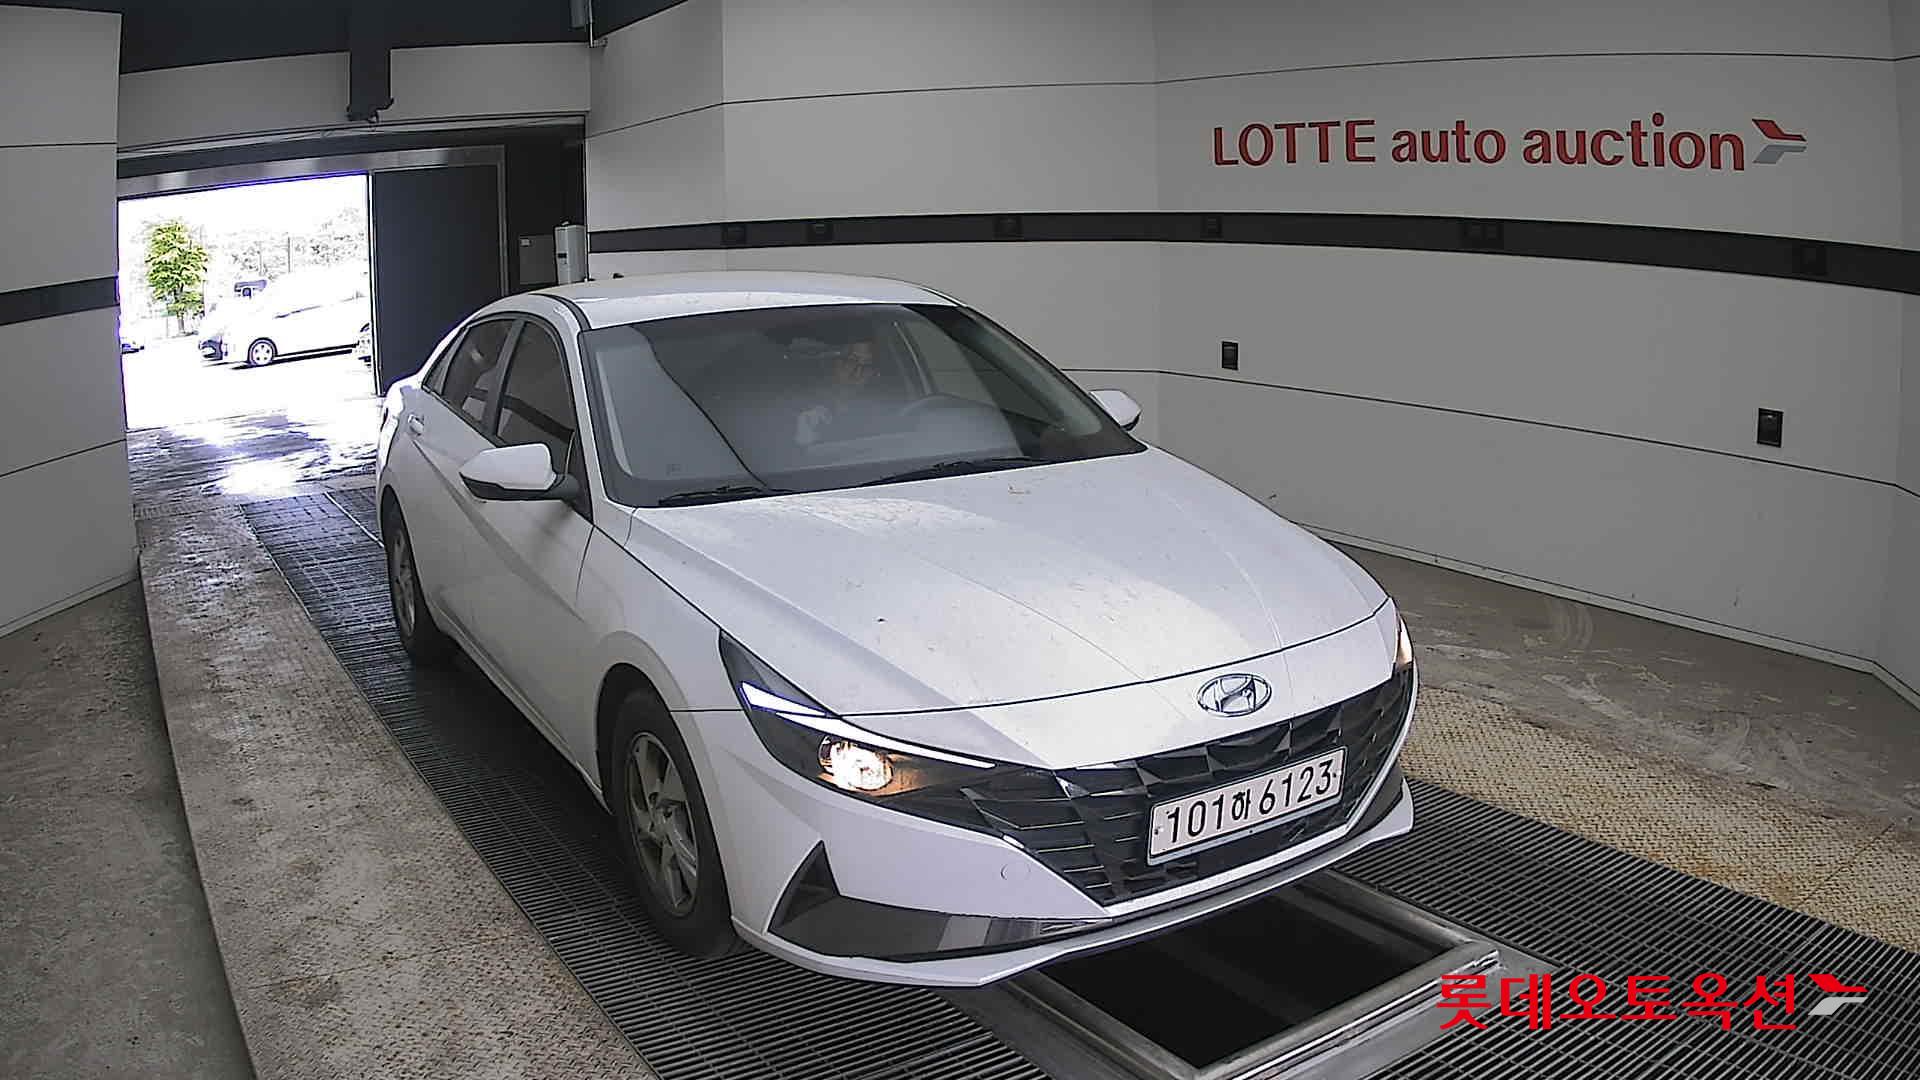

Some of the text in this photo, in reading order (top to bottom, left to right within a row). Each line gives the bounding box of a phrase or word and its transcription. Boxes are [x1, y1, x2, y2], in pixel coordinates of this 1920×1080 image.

[1214, 112, 1746, 171] LOTTE auto auction
